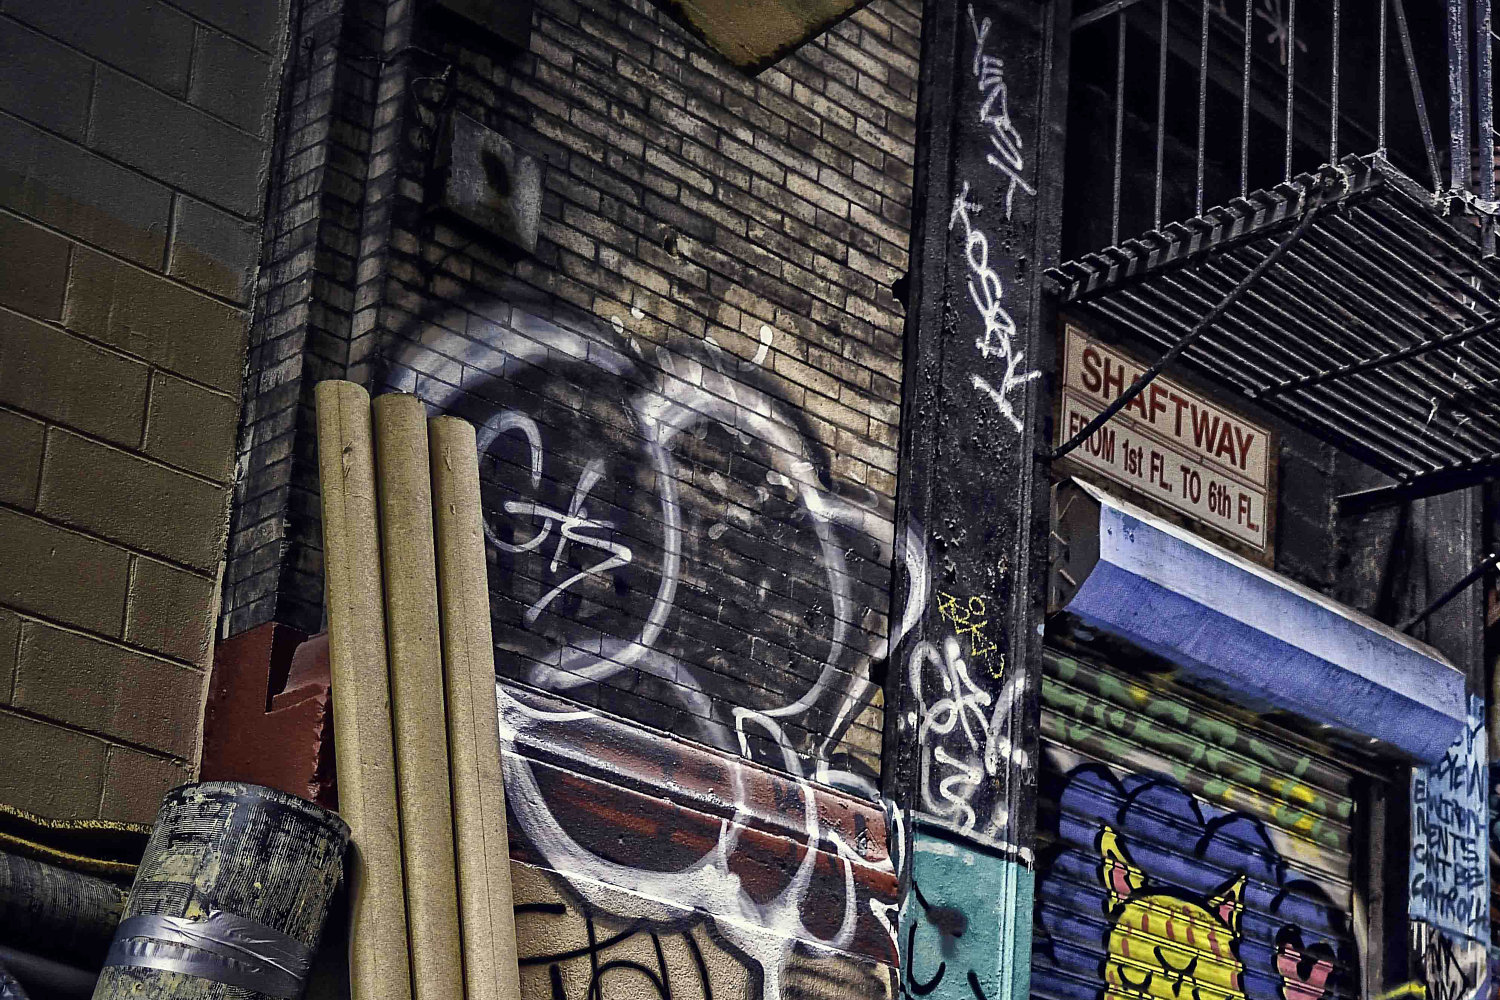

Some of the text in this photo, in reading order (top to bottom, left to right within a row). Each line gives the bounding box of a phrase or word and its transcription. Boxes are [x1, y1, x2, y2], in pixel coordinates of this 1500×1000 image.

[1080, 348, 1255, 471] SHAFTWAY
[1122, 439, 1144, 478] 1st
[1150, 450, 1173, 493] FL.
[1180, 464, 1202, 505] TO
[1208, 481, 1232, 520] 6th
[1237, 492, 1260, 533] FL.
